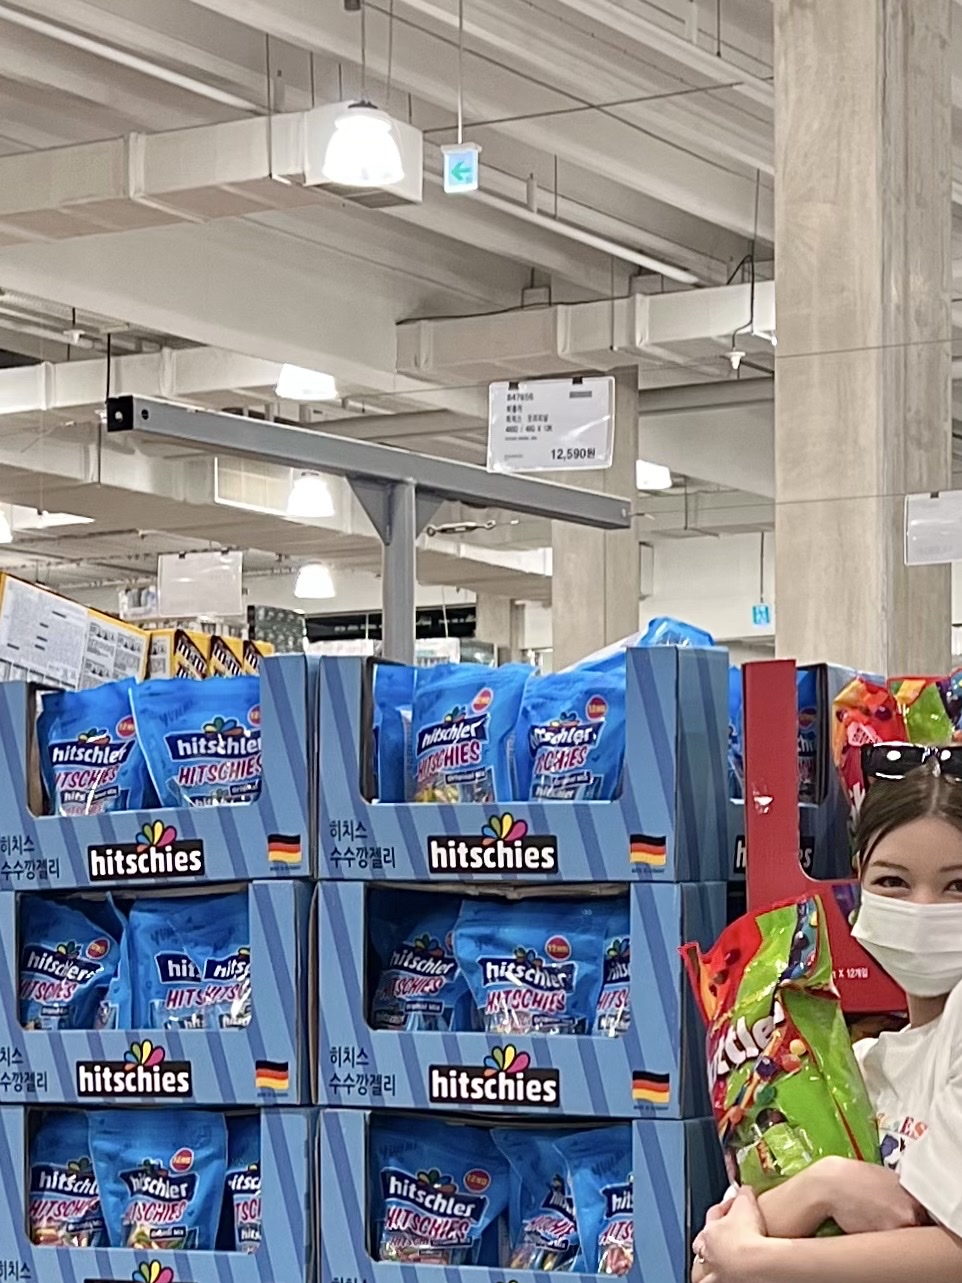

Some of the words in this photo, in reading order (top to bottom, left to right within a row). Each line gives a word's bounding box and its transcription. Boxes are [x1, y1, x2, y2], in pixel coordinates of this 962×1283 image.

[551, 448, 595, 460] 12,590원
[329, 820, 368, 840] 히치스
[90, 847, 201, 876] hitschies
[330, 846, 395, 869] 수수깡젤리
[431, 840, 555, 870] hitschies
[329, 1046, 369, 1067] 히치스
[79, 1065, 189, 1093] hitschies
[329, 1073, 395, 1097] 수수깡젤리
[432, 1071, 557, 1103] hitschies
[389, 1176, 477, 1220] hitschler
